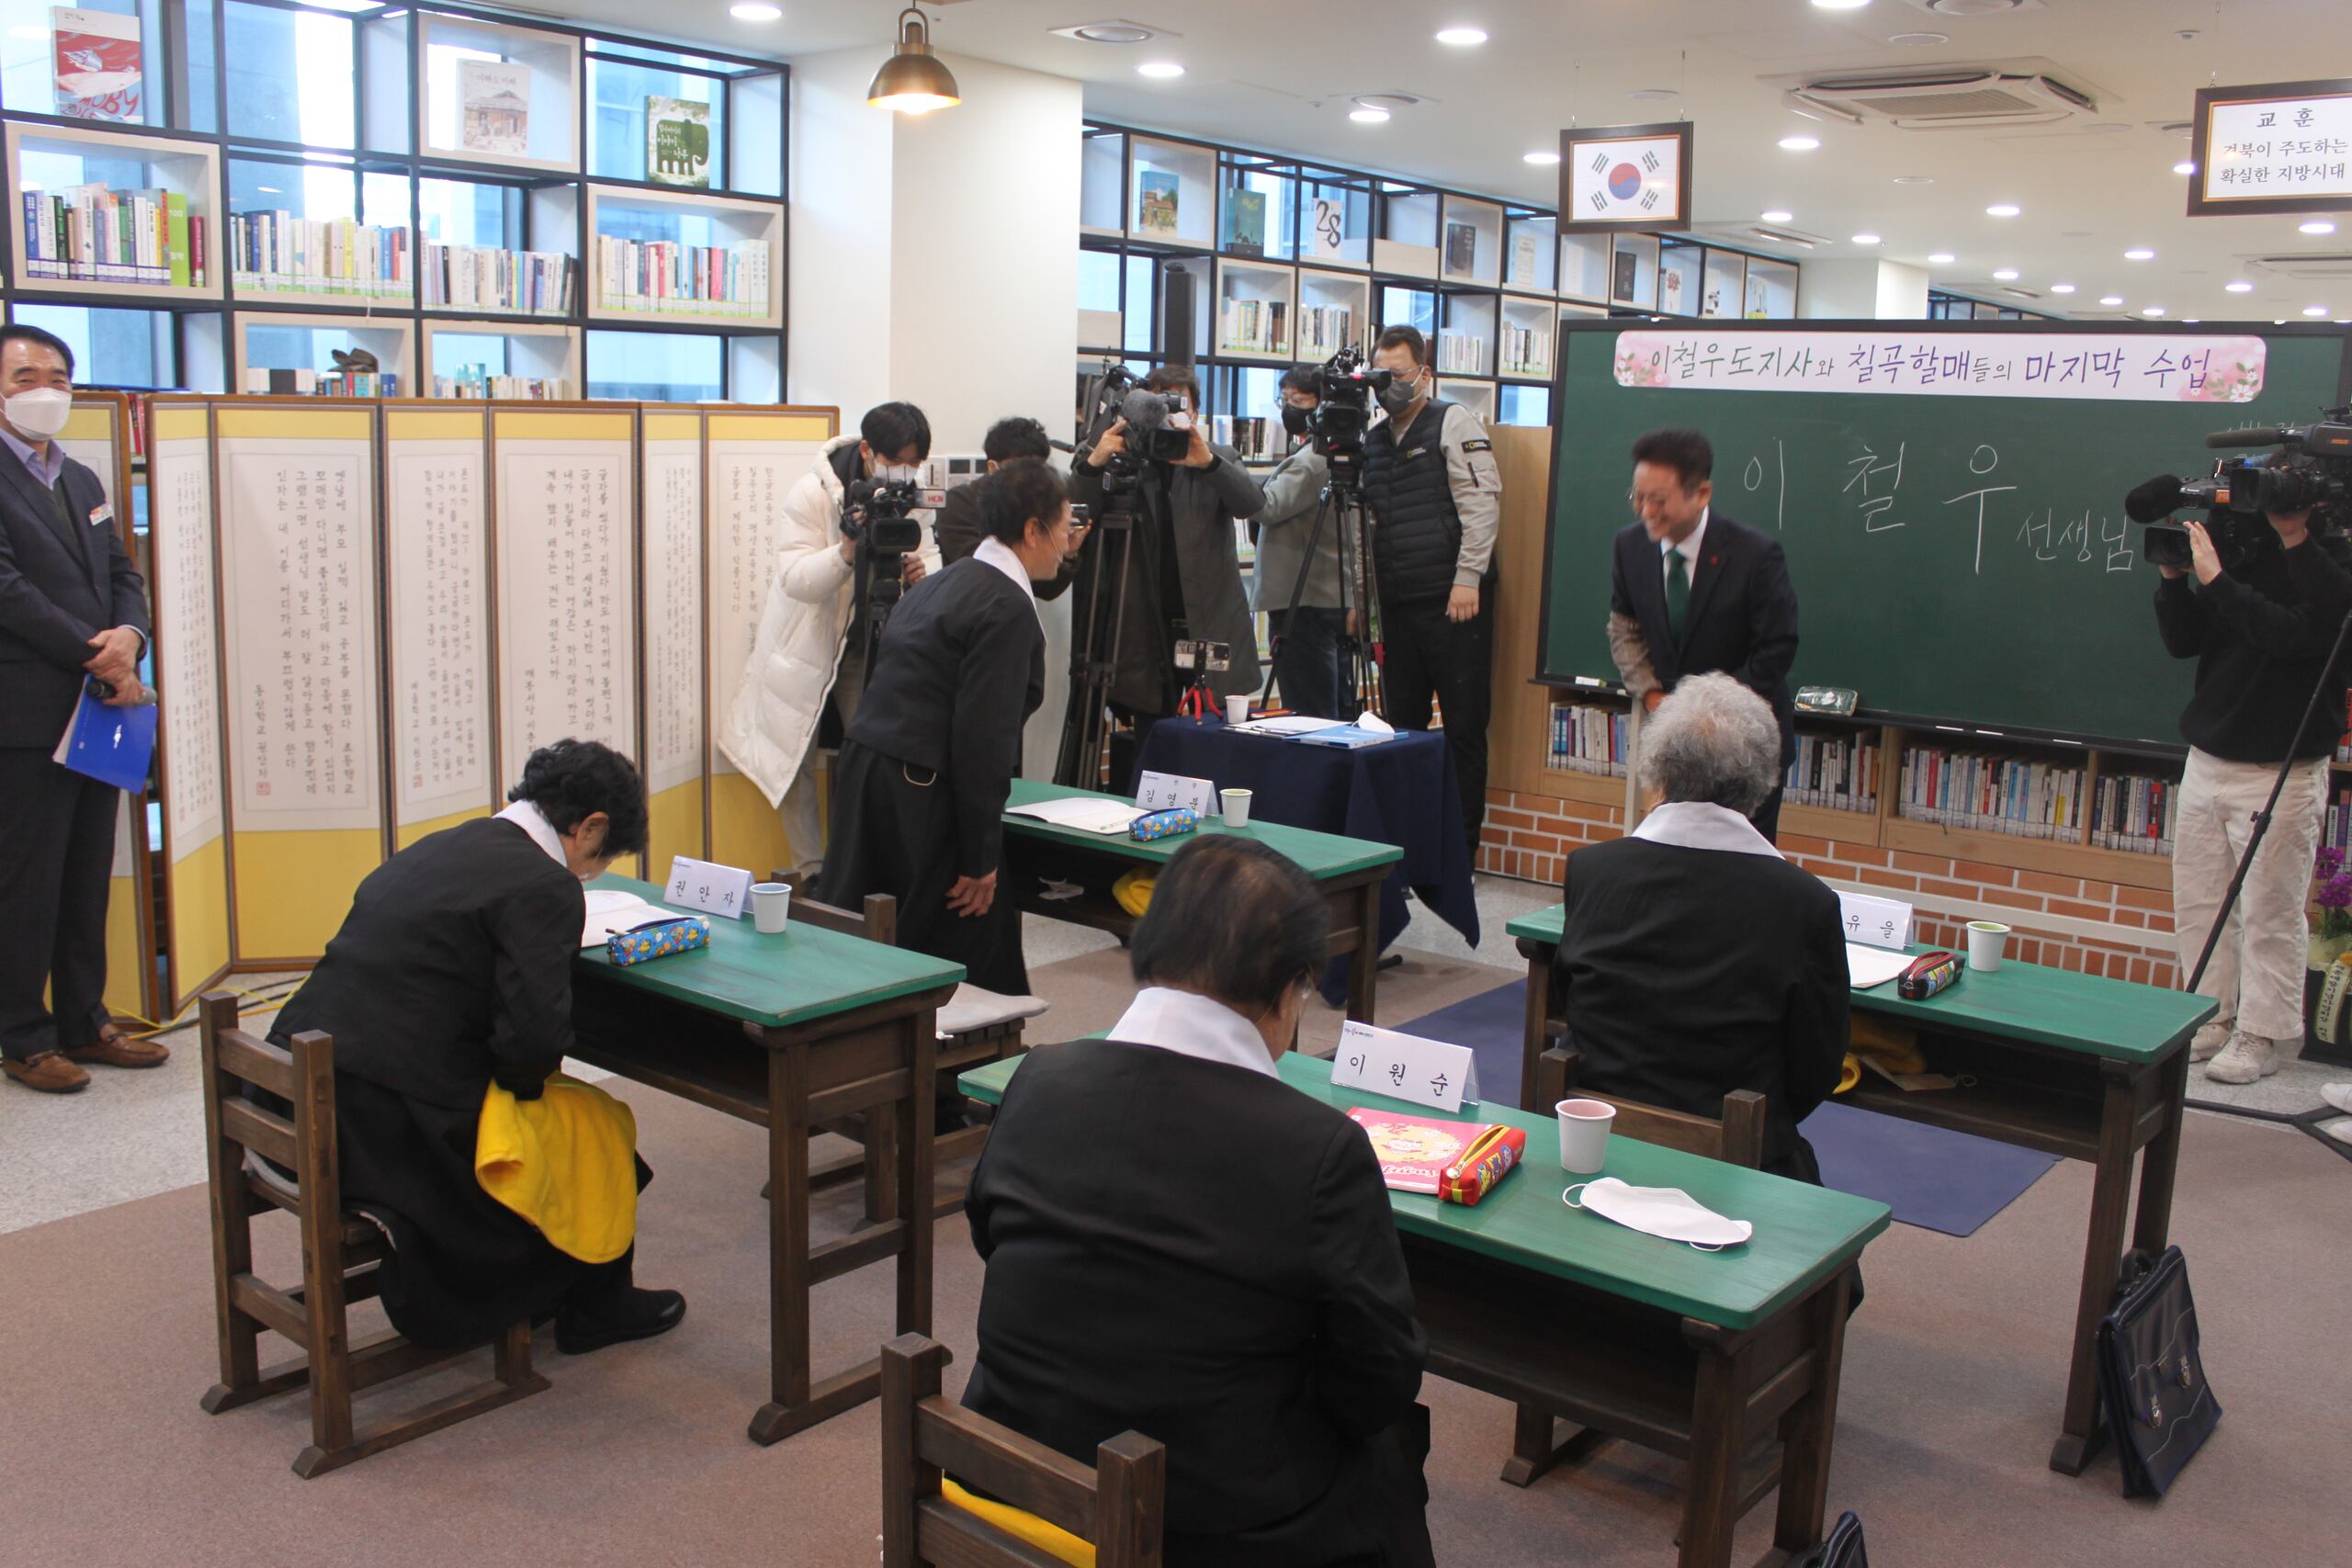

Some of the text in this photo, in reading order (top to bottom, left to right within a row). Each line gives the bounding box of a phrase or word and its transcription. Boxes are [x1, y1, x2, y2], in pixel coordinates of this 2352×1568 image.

[2256, 107, 2315, 128] 교 훈
[2278, 138, 2348, 157] 주도하는
[2221, 163, 2346, 184] 확실한 지방시대
[1316, 200, 1341, 249] 28
[1847, 343, 2011, 385] 칠곡할매들의
[2025, 351, 2125, 389] 마지막
[2143, 351, 2211, 390] 수업
[335, 469, 346, 512] 옛날에
[563, 469, 573, 494] 내가
[598, 468, 609, 505] 글자를
[747, 466, 758, 513] 칠곡군의
[764, 467, 775, 526] 한글교육을
[277, 522, 288, 535] 내
[316, 519, 328, 558] 다니면
[731, 511, 741, 546] 제작한
[2017, 509, 2134, 573] 선생님
[298, 537, 310, 579] 선생님
[747, 523, 758, 581] 평생교육을
[299, 590, 311, 615] 말도
[731, 555, 742, 615] 작품입니다
[748, 590, 758, 613] 통해
[320, 642, 331, 666] 하고
[339, 637, 350, 679] 공부를
[301, 675, 314, 728] 알아듣고
[321, 676, 333, 714] 마음에
[341, 688, 352, 729] 못했다
[322, 723, 334, 749] 한이
[343, 742, 355, 795] 초등학교
[1146, 789, 1155, 803] 김
[1167, 793, 1177, 807] 영
[675, 880, 734, 908] 권 안 자
[1846, 915, 1895, 939] 유 을
[1350, 1053, 1449, 1097] 이 원 순
